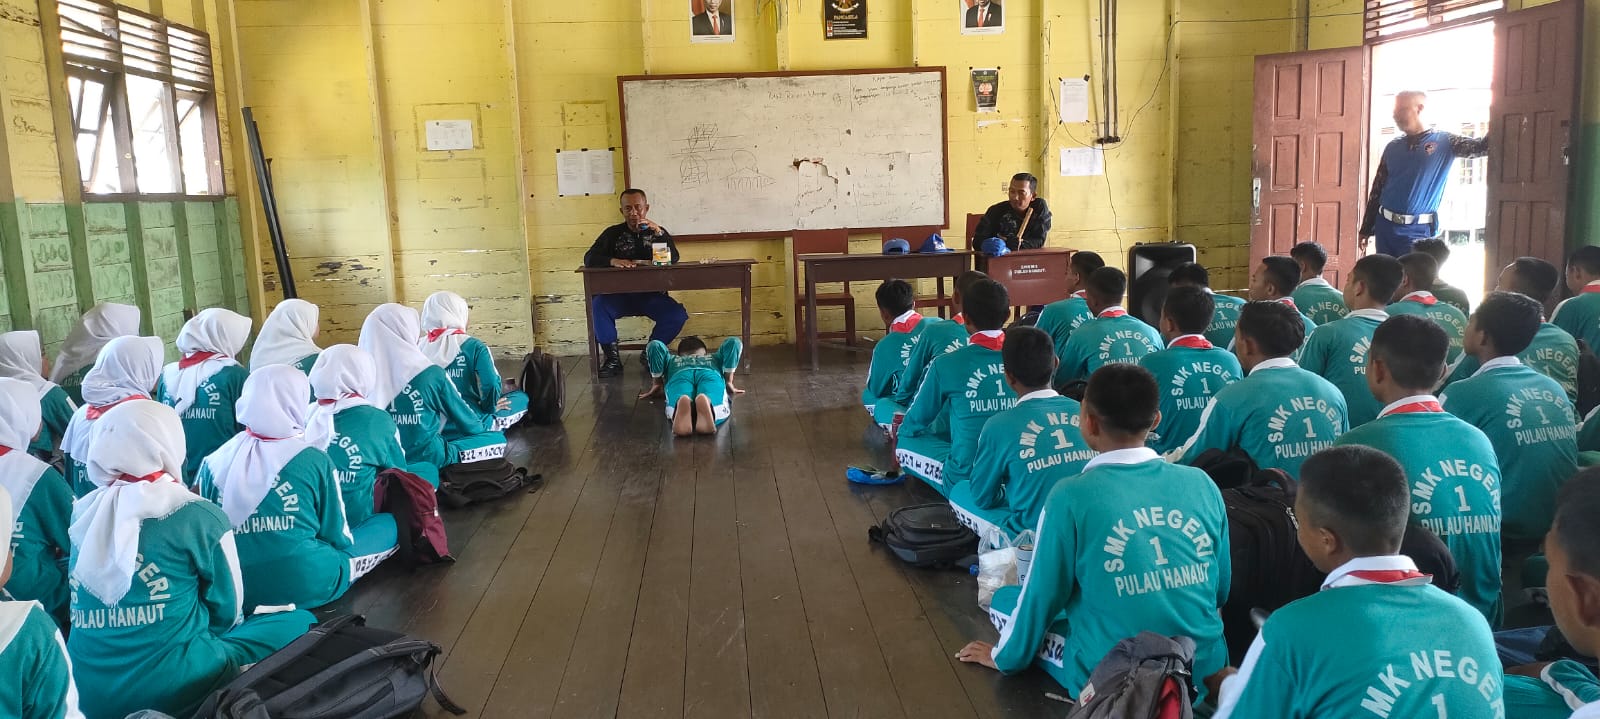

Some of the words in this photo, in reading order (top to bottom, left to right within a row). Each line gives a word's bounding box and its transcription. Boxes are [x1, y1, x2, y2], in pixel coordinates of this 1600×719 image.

[1217, 310, 1228, 320] 1
[1317, 301, 1346, 317] NEGE
[1070, 313, 1086, 329] MK
[944, 338, 964, 354] MK
[1099, 334, 1116, 360] SMK
[1115, 330, 1158, 354] NEGER
[1123, 342, 1133, 356] 1
[447, 368, 464, 378] NAUT
[965, 368, 988, 399] SMK
[1171, 366, 1193, 396] SMK
[1192, 361, 1235, 385] NEGE
[200, 378, 220, 406] GERI
[995, 379, 1006, 396] 1
[1200, 377, 1211, 394] 1
[401, 384, 425, 412] GERI
[969, 399, 999, 413] PULAU
[1000, 397, 1017, 411] HAN
[1176, 396, 1205, 411] PULAU
[185, 408, 216, 420] HANAUT
[392, 413, 422, 425] HANAUT
[1505, 393, 1525, 429] SMK
[1536, 405, 1551, 425] 1
[1268, 404, 1293, 443] SMK
[1303, 417, 1317, 438] 1
[1019, 420, 1045, 459] SMK
[1046, 412, 1081, 427] NEG
[1050, 428, 1074, 450] 1
[1515, 427, 1547, 446] PULAU
[330, 432, 362, 469] EGERI
[1274, 441, 1309, 460] PULAU
[1026, 453, 1062, 474] PULAU
[337, 470, 357, 483] AUT
[271, 475, 300, 512] GERI
[1412, 467, 1442, 514] SMK
[1454, 485, 1471, 512] 1
[252, 515, 296, 533] HANAUT
[1103, 518, 1136, 573] SMK
[1133, 506, 1213, 558] NEGERI
[1149, 536, 1168, 565] 1
[134, 552, 171, 600] GERI
[1114, 571, 1161, 597] PULAU
[1162, 562, 1210, 589] HANAUT
[108, 603, 166, 628] HANAUT
[1360, 663, 1412, 719] MK
[1431, 693, 1448, 719] 1
